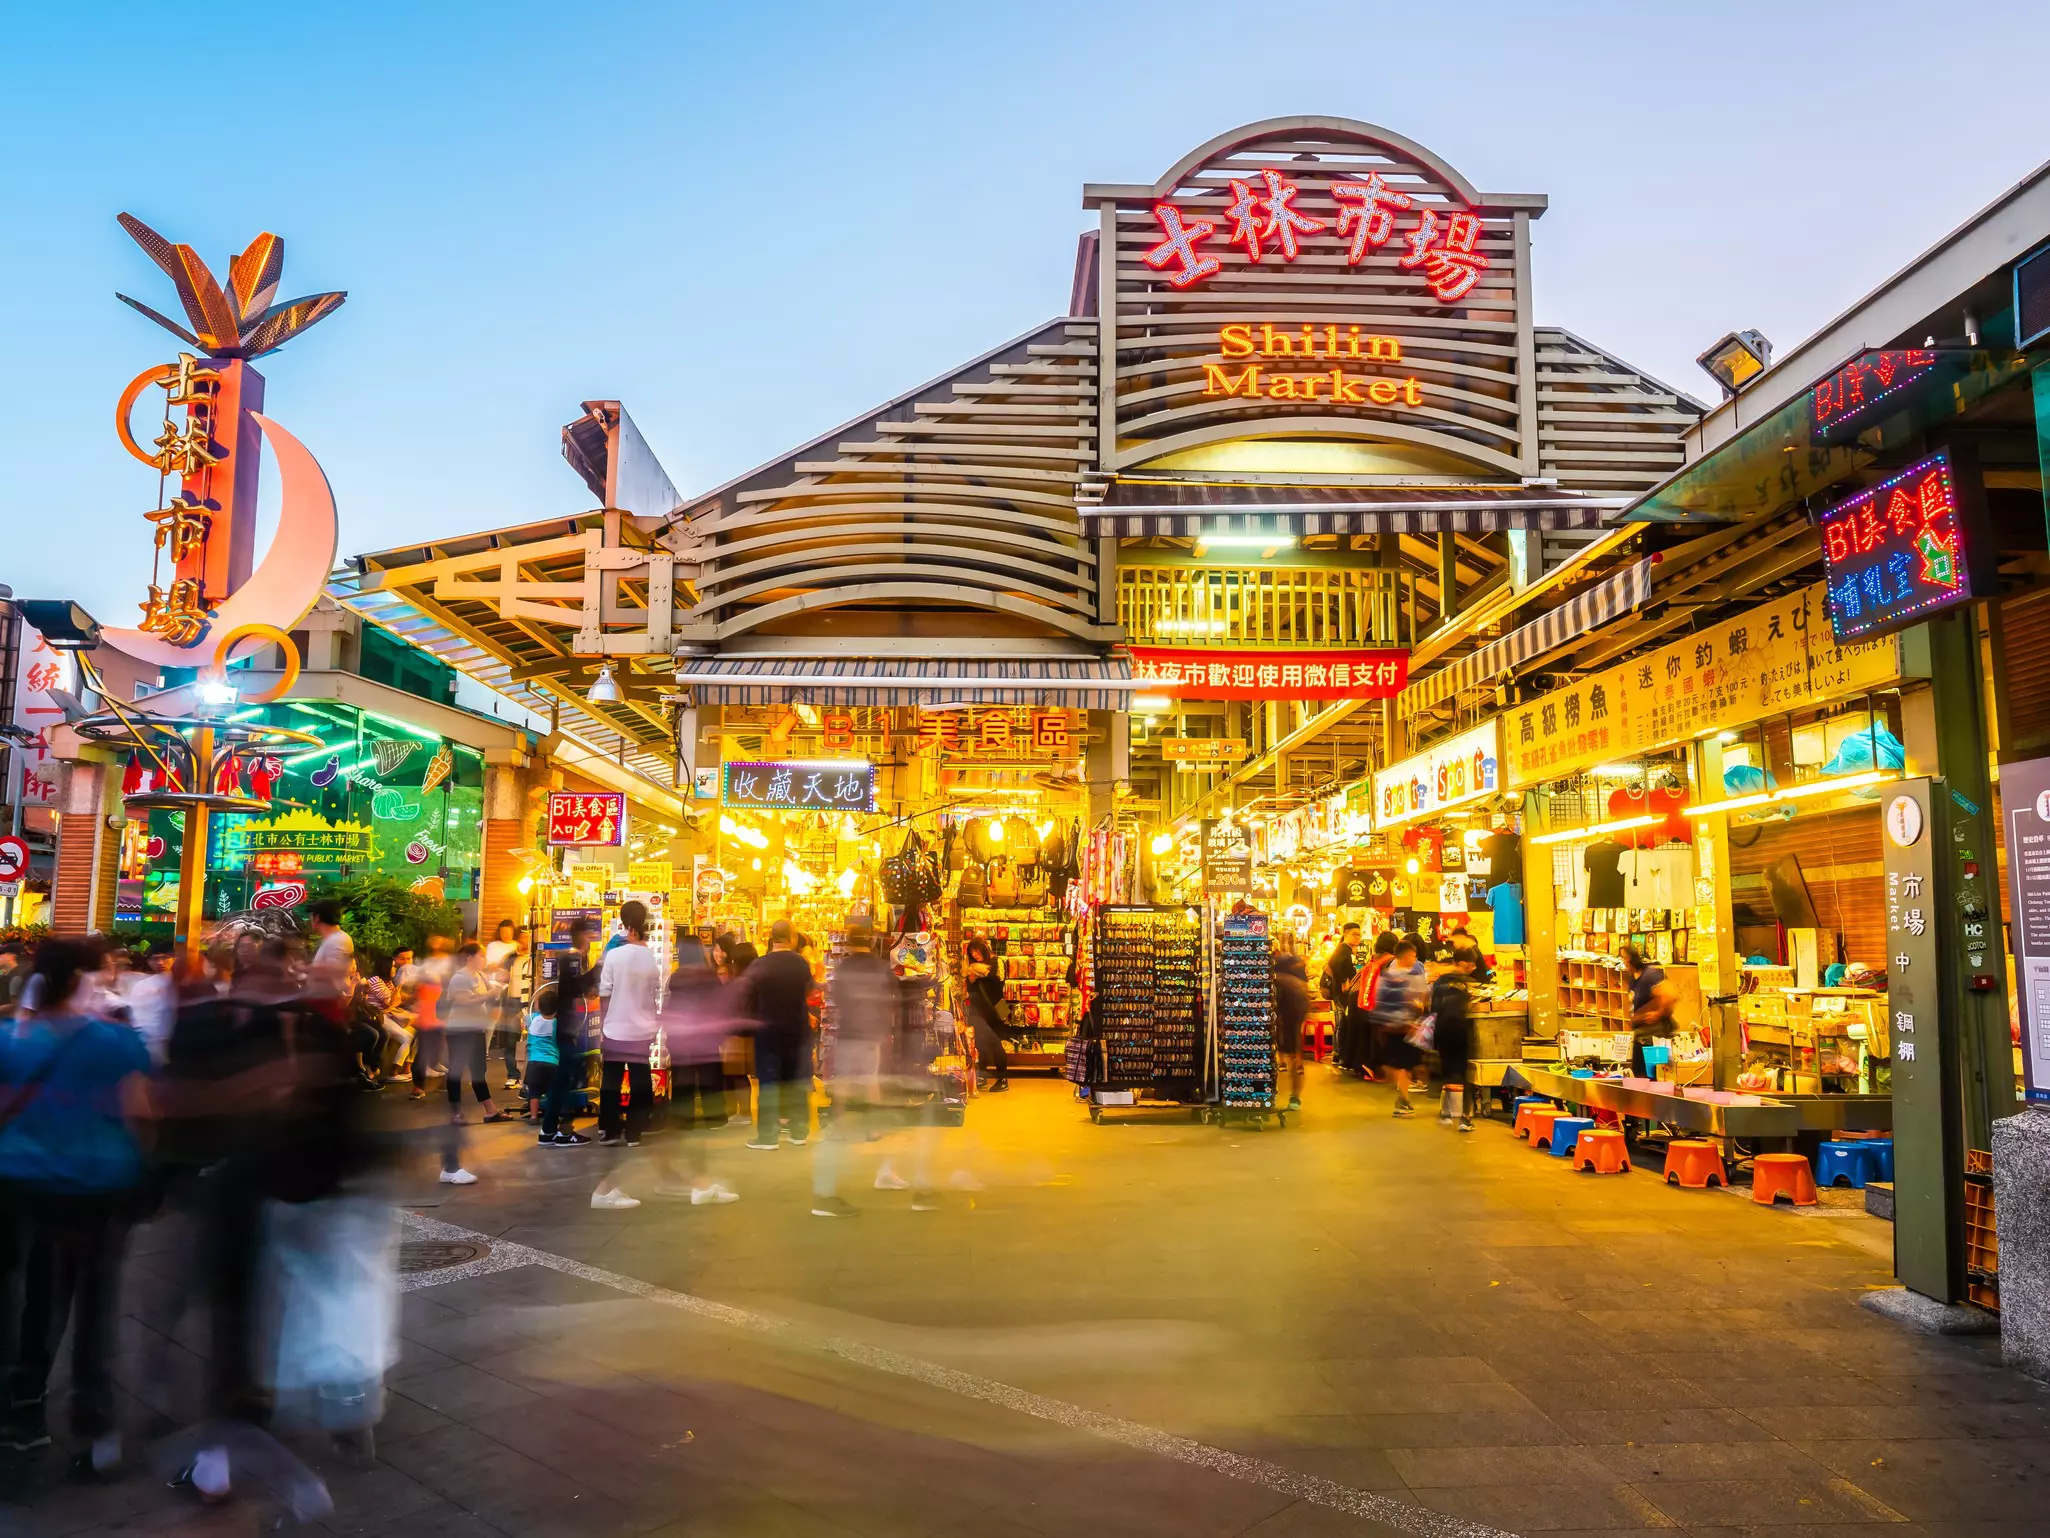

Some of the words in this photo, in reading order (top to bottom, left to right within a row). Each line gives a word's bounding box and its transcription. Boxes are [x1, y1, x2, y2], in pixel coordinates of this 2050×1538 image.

[1142, 168, 1489, 302] 士林市場
[1219, 322, 1404, 362] Shilin
[1202, 363, 1424, 408] Market
[136, 351, 222, 648] 士林市場
[1131, 659, 1399, 688] 林夜市歡迎使用微信支付
[1637, 627, 1749, 691] 迷你釣蝦
[1519, 683, 1609, 746] 高級撈魚
[734, 768, 864, 804] 收藏天地
[553, 797, 619, 818] B1美食區
[414, 829, 447, 856] Fresh
[552, 824, 574, 834] 入口
[306, 855, 333, 863] PUBLIC
[336, 854, 365, 863] MARKET
[638, 874, 660, 885] 100
[1215, 873, 1240, 885] 290
[1888, 872, 1901, 932] Market
[1902, 872, 1926, 937] 市場
[1964, 923, 1983, 936] HC
